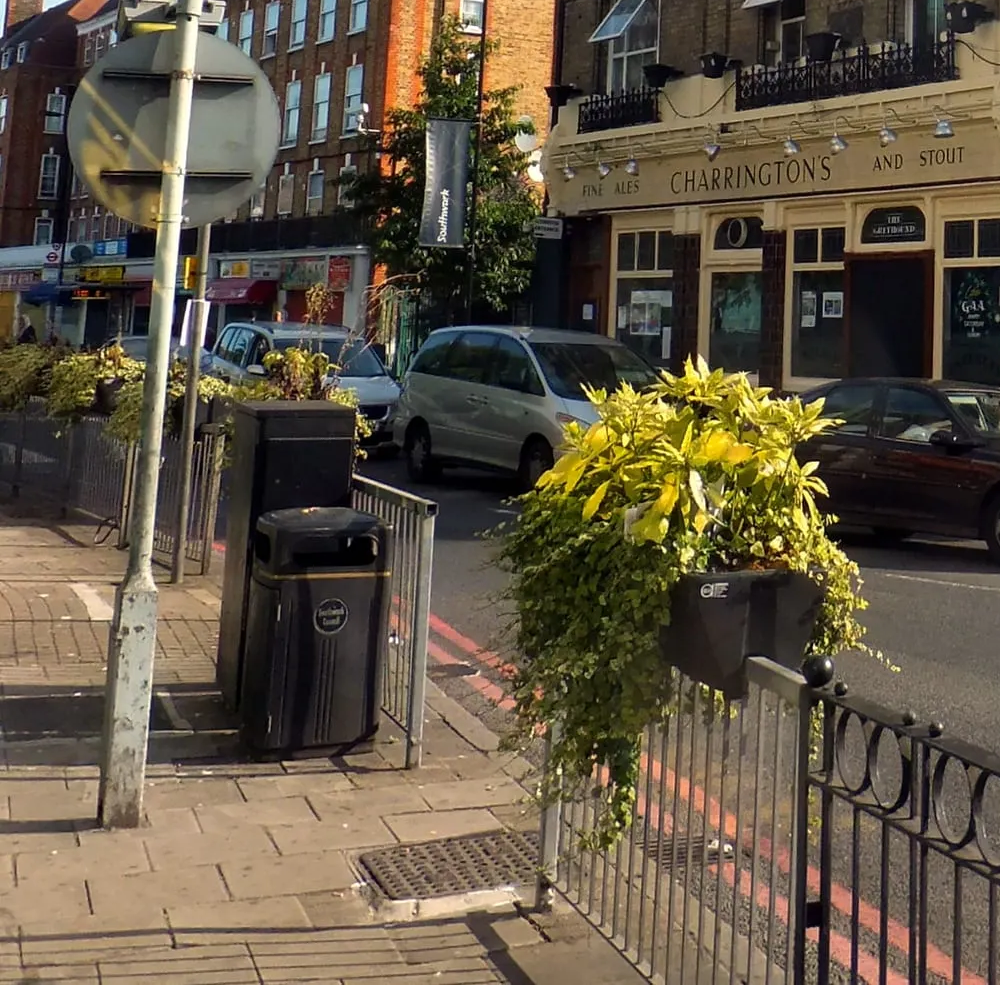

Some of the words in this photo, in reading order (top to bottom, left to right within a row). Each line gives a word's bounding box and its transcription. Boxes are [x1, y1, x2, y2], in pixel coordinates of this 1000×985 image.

[582, 183, 604, 197] FINE
[614, 179, 641, 195] ALES
[670, 156, 832, 194] CHARRINGTON'S
[872, 152, 905, 172] AND
[919, 146, 966, 167] STOUT
[437, 188, 450, 243] Southwark
